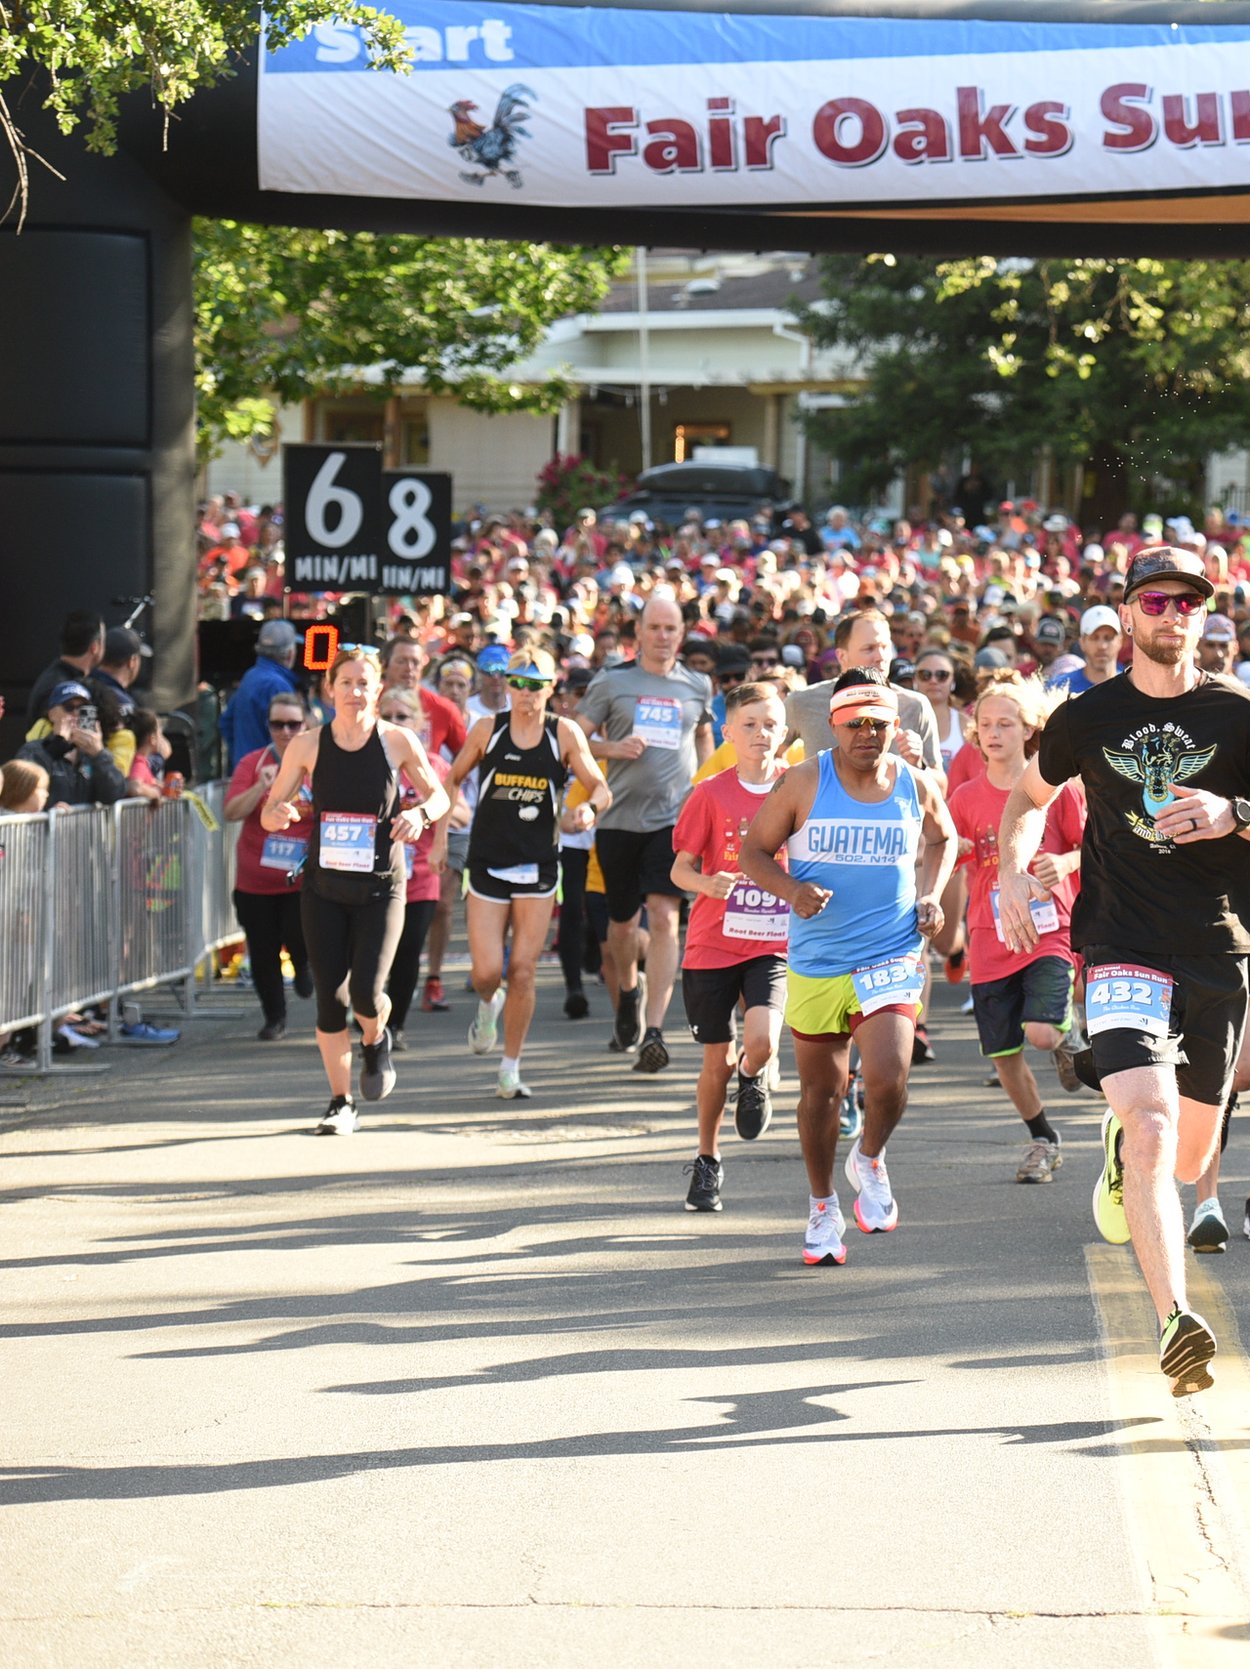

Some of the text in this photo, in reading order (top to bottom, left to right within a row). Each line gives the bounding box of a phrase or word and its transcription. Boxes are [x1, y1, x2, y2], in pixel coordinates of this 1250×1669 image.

[583, 96, 786, 175] Fair
[812, 85, 1075, 168] Oaks
[305, 452, 363, 548] 6
[387, 478, 437, 560] 8
[294, 554, 378, 584] MIN/MI
[304, 625, 339, 670] 0
[639, 706, 673, 722] 745
[1121, 721, 1197, 752] Blood, Sweat
[494, 773, 548, 790] BUFFALO
[508, 787, 546, 803] CHIPS
[324, 825, 363, 842] 457
[835, 854, 897, 864] 502. N14
[859, 965, 909, 990] 183
[1093, 969, 1168, 984] Fair Oaks Sun Run
[1091, 981, 1153, 1006] 432
